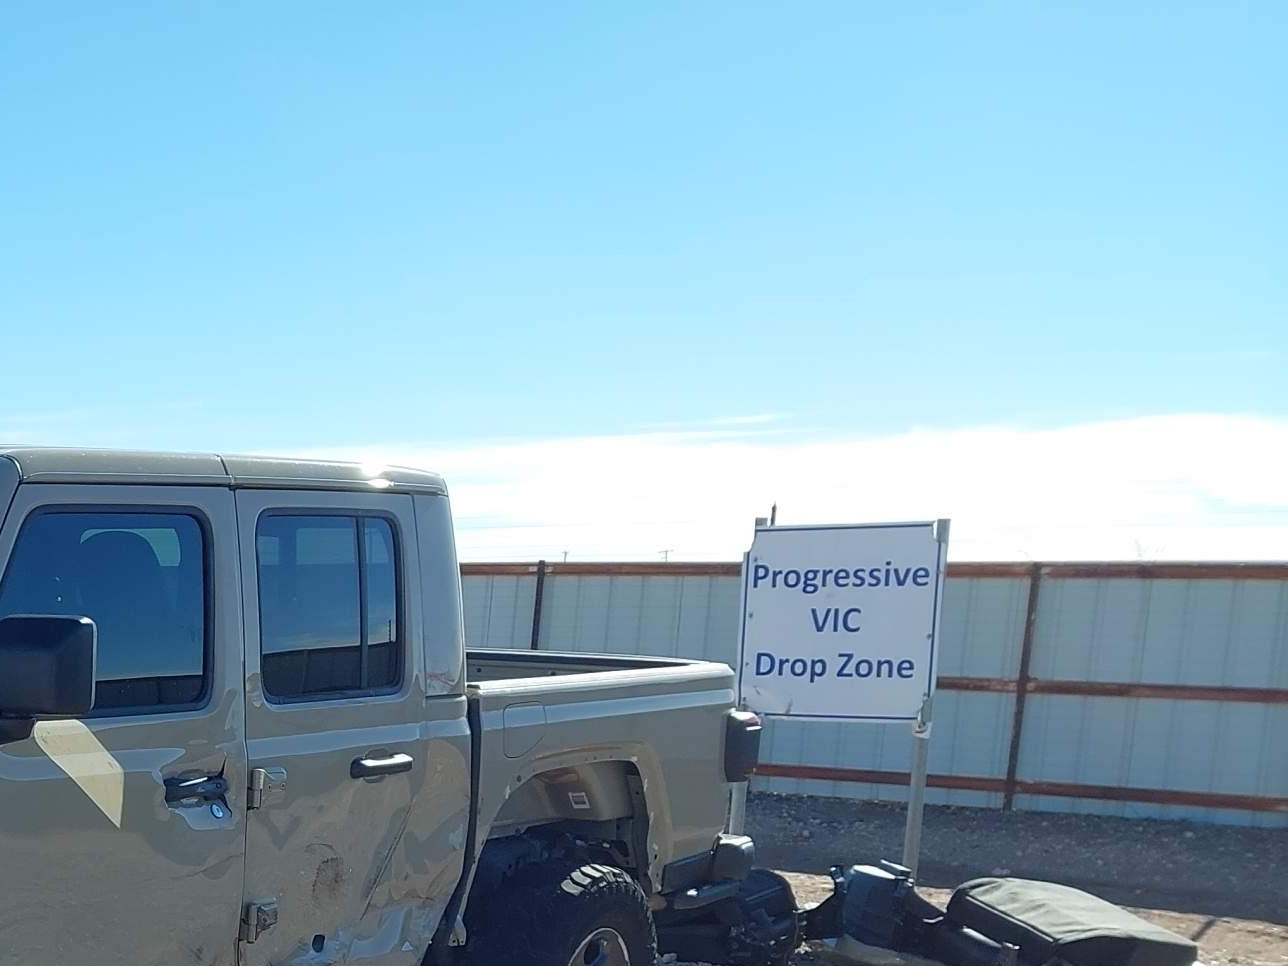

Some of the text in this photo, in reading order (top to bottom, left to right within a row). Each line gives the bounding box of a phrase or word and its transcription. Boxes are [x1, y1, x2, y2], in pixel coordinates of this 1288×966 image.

[752, 561, 931, 594] Progressive
[810, 607, 862, 633] VIC
[754, 652, 916, 683] Drop Zone
